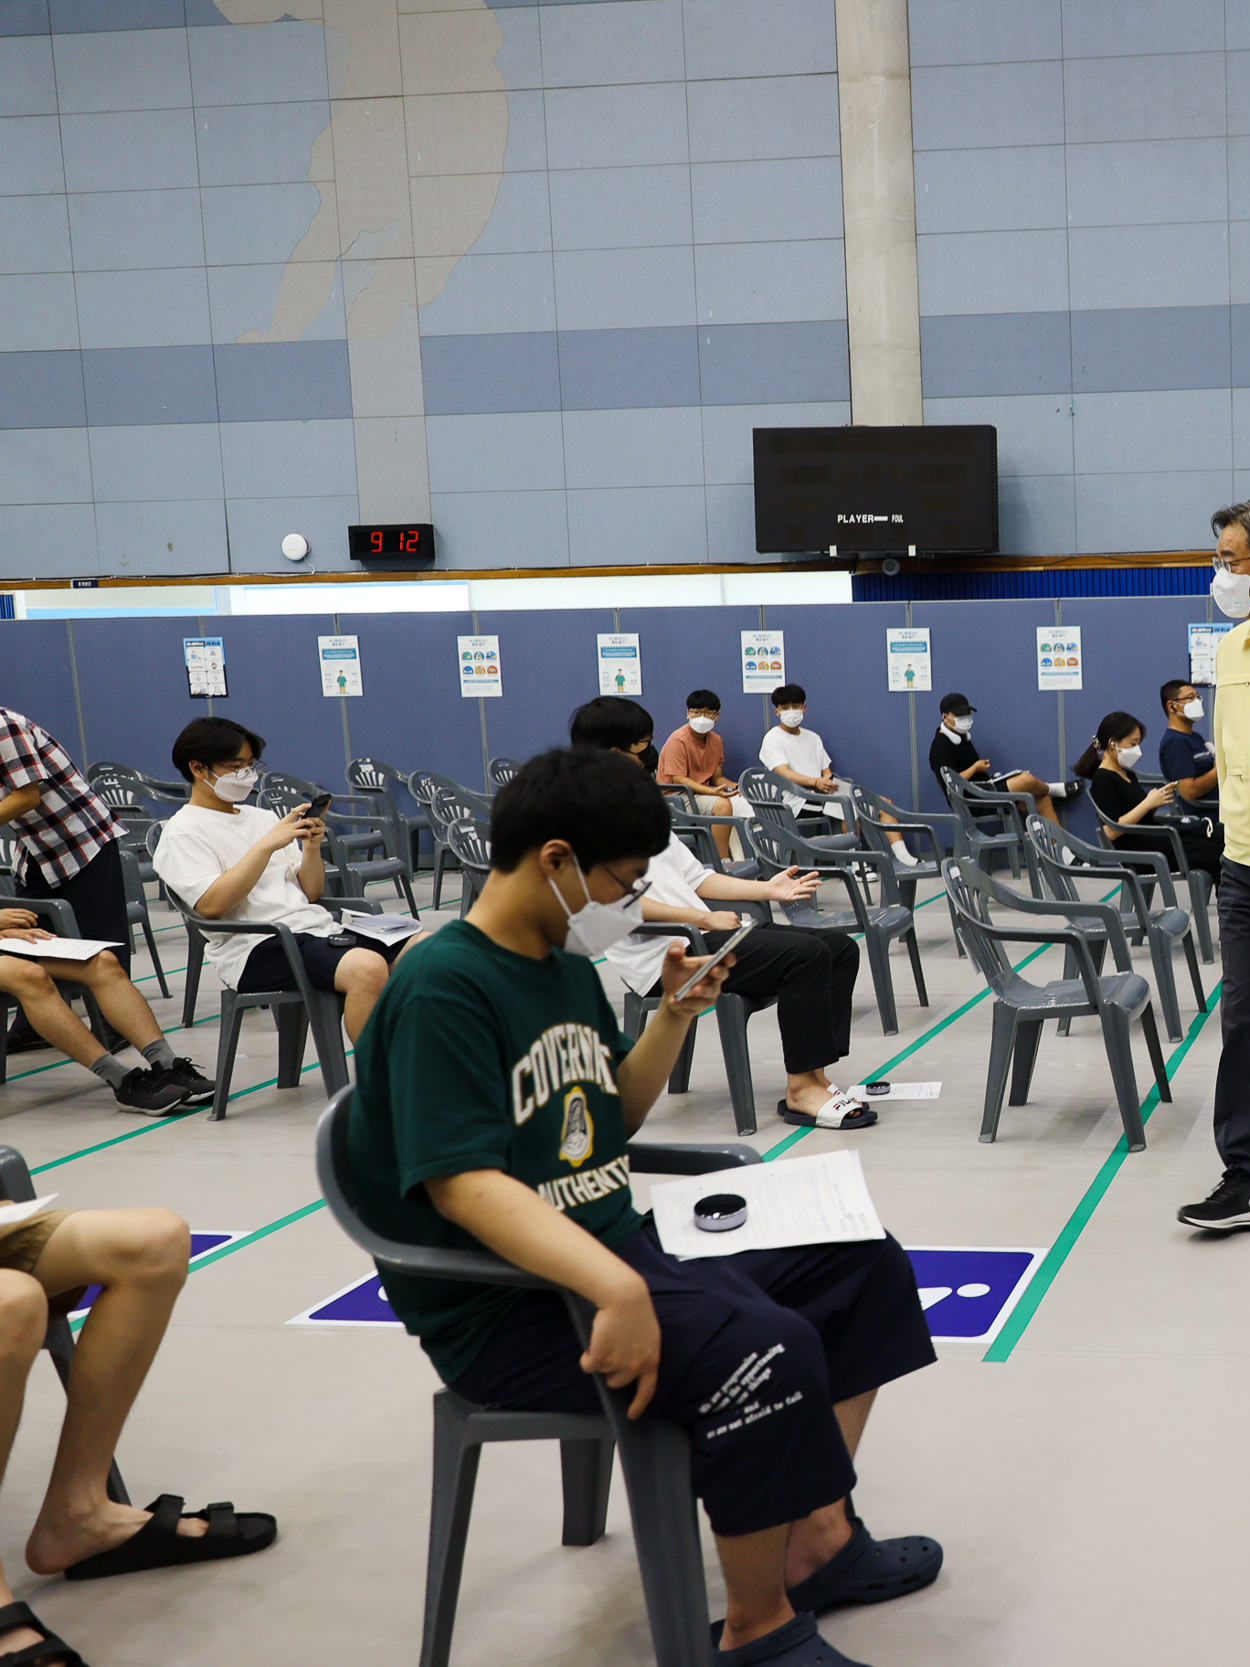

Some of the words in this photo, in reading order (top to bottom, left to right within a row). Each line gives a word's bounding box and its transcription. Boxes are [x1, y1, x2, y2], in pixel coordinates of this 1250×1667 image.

[837, 514, 875, 524] PLAYER
[370, 531, 383, 553] 9
[399, 530, 419, 552] 12
